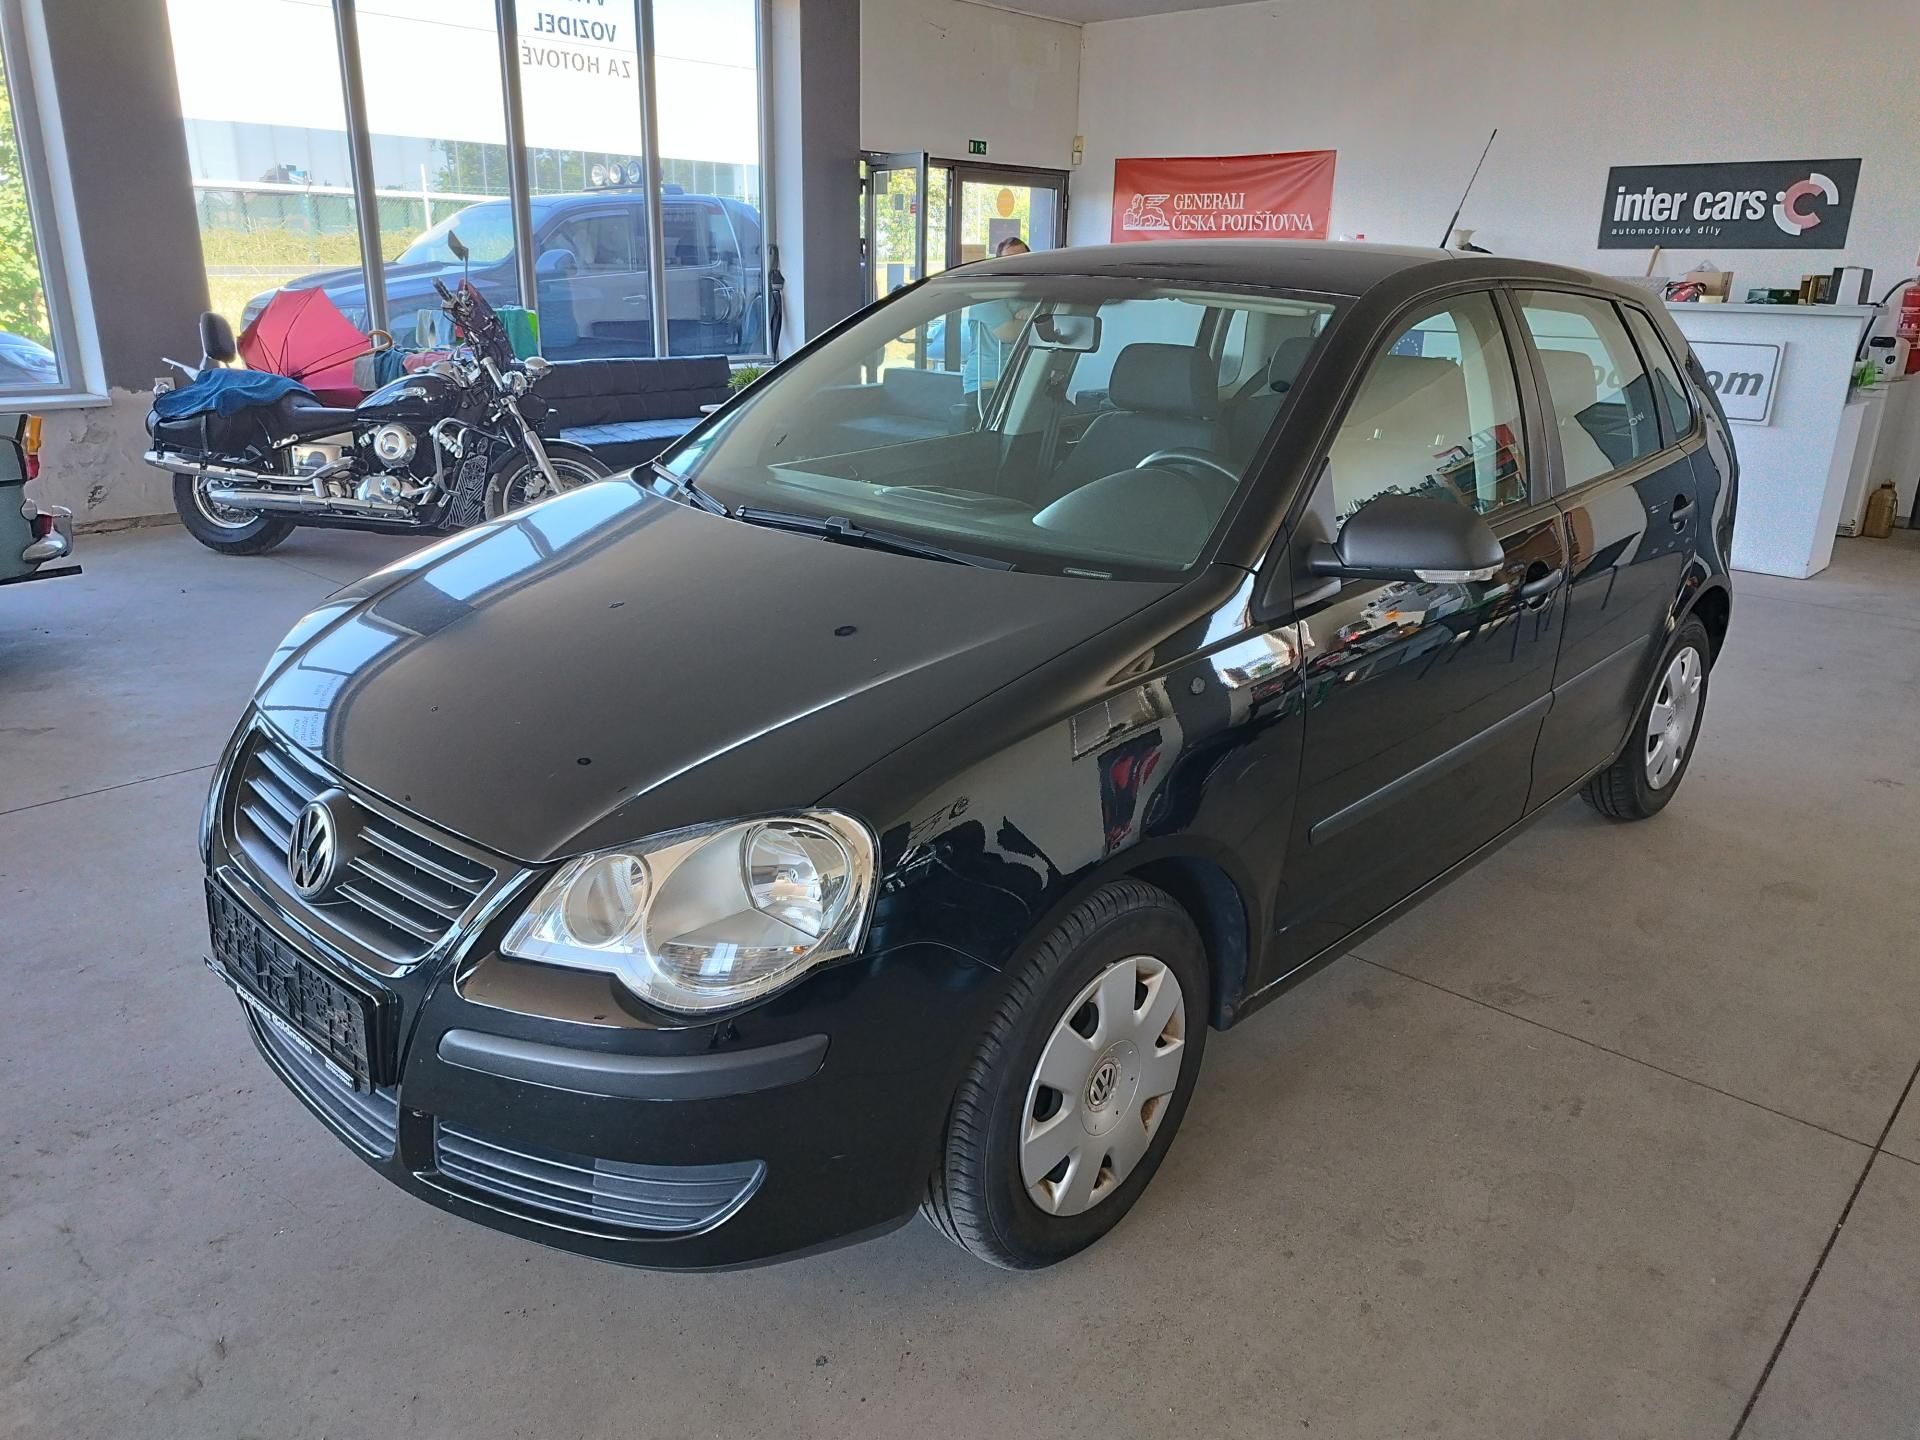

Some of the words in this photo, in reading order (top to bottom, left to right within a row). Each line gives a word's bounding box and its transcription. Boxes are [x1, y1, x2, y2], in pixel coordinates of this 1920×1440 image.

[1173, 192, 1246, 211] GENERALI
[1613, 185, 1688, 222] inter
[1693, 190, 1768, 222] cars
[1171, 210, 1218, 232] ČESKÁ
[1220, 210, 1314, 232] POJIŠŤOVNA
[1611, 225, 1692, 236] automobilové
[1697, 225, 1721, 236] díly
